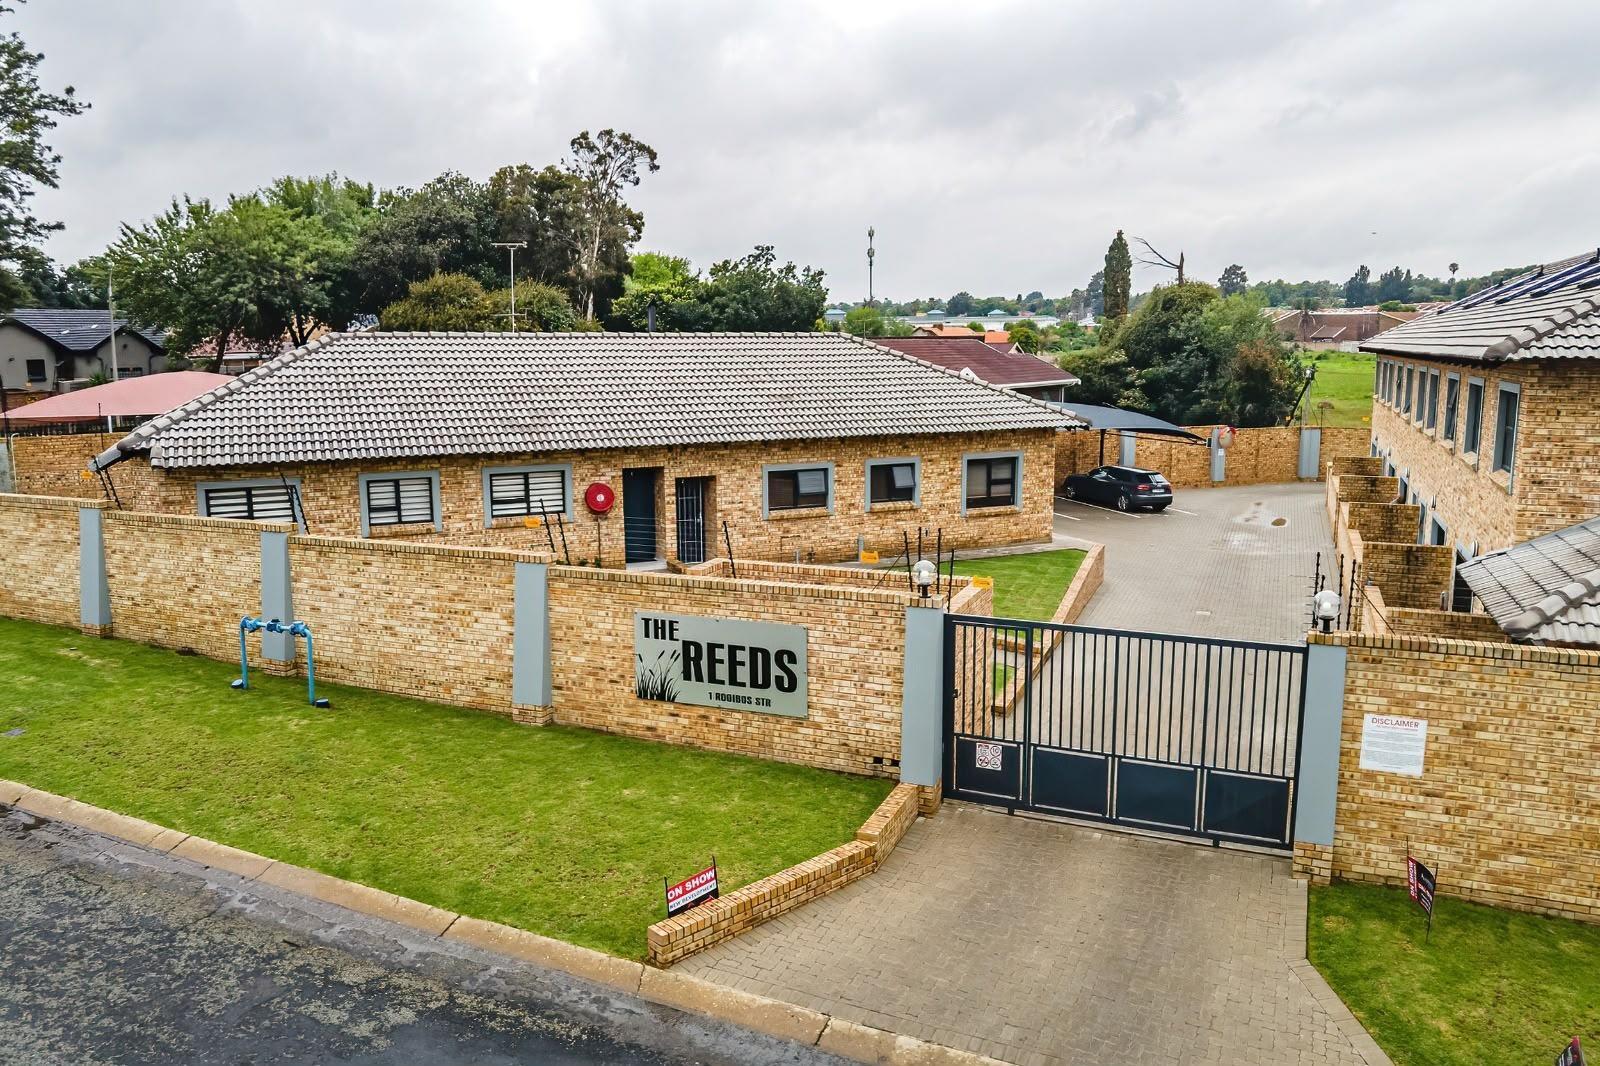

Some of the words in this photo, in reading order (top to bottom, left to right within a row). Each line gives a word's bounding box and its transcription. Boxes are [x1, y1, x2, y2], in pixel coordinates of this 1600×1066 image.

[641, 617, 679, 641] THE
[682, 640, 797, 693] REEDS
[708, 692, 713, 700] 1
[715, 693, 752, 705] ROOIBOS
[755, 697, 771, 707] STR
[1371, 717, 1419, 728] DISCLAIMER
[667, 886, 683, 899] ON
[685, 868, 714, 891] SHOW
